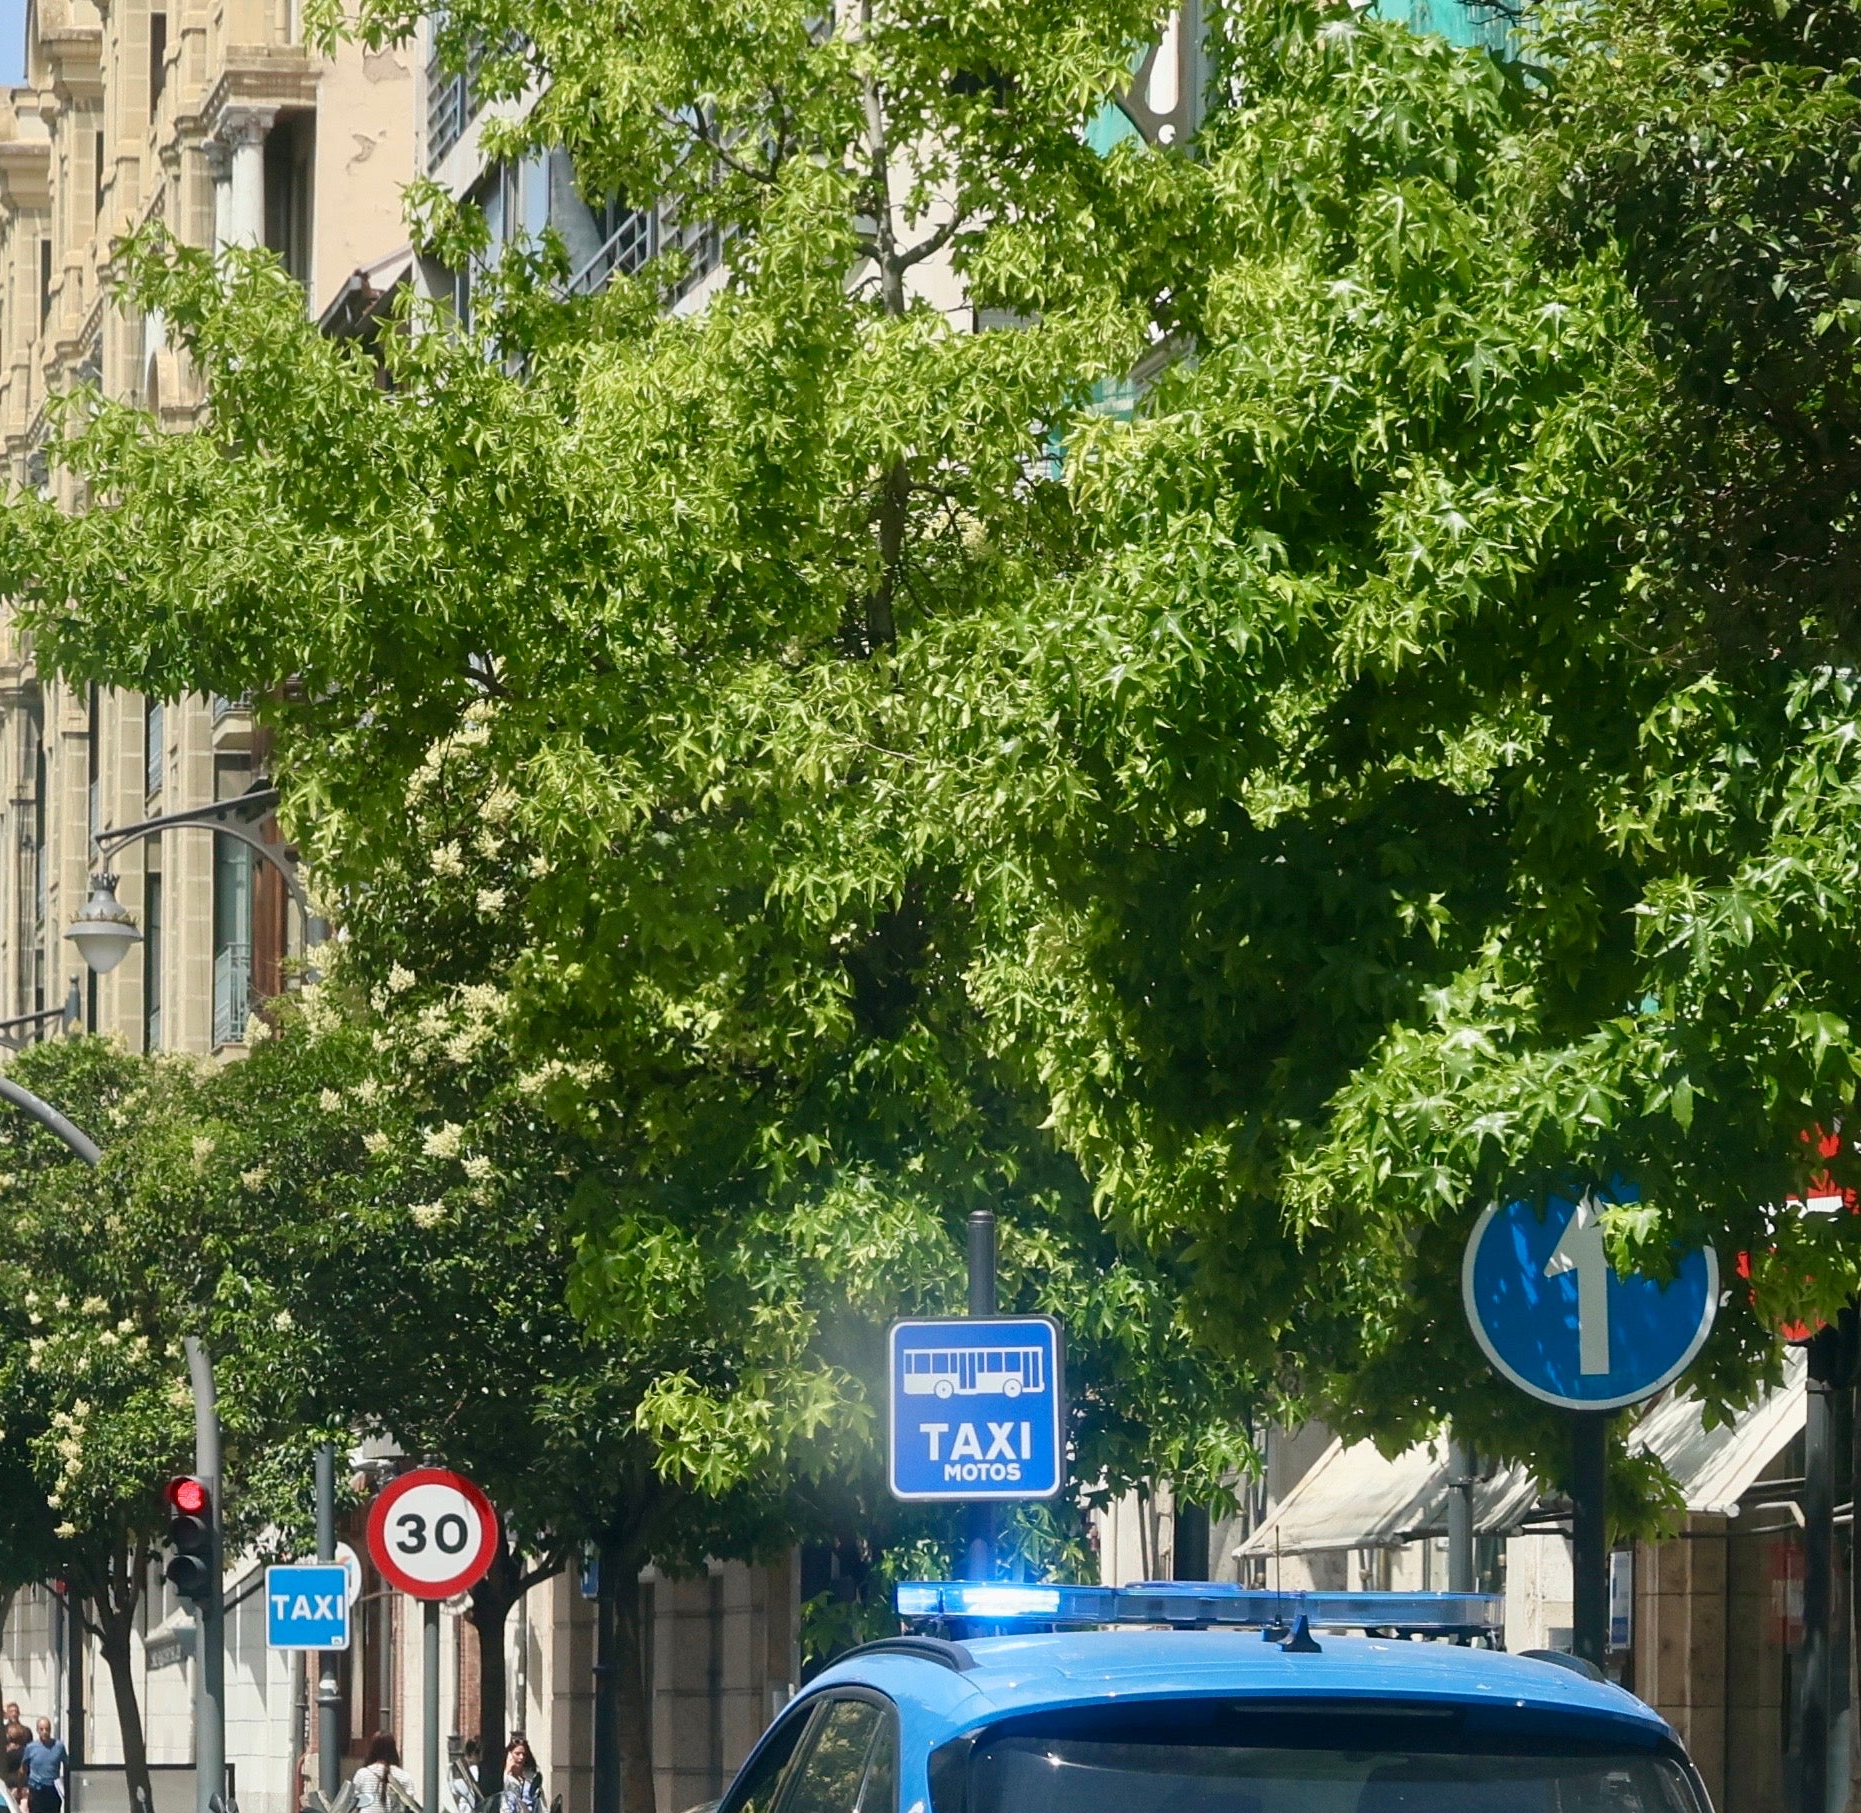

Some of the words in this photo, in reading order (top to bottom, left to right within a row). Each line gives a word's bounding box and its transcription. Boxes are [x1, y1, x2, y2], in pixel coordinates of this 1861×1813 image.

[919, 1422, 1032, 1461] TAXI
[943, 1462, 1022, 1482] MOTOS
[395, 1513, 468, 1555] 30
[270, 1594, 344, 1621] TAXI
